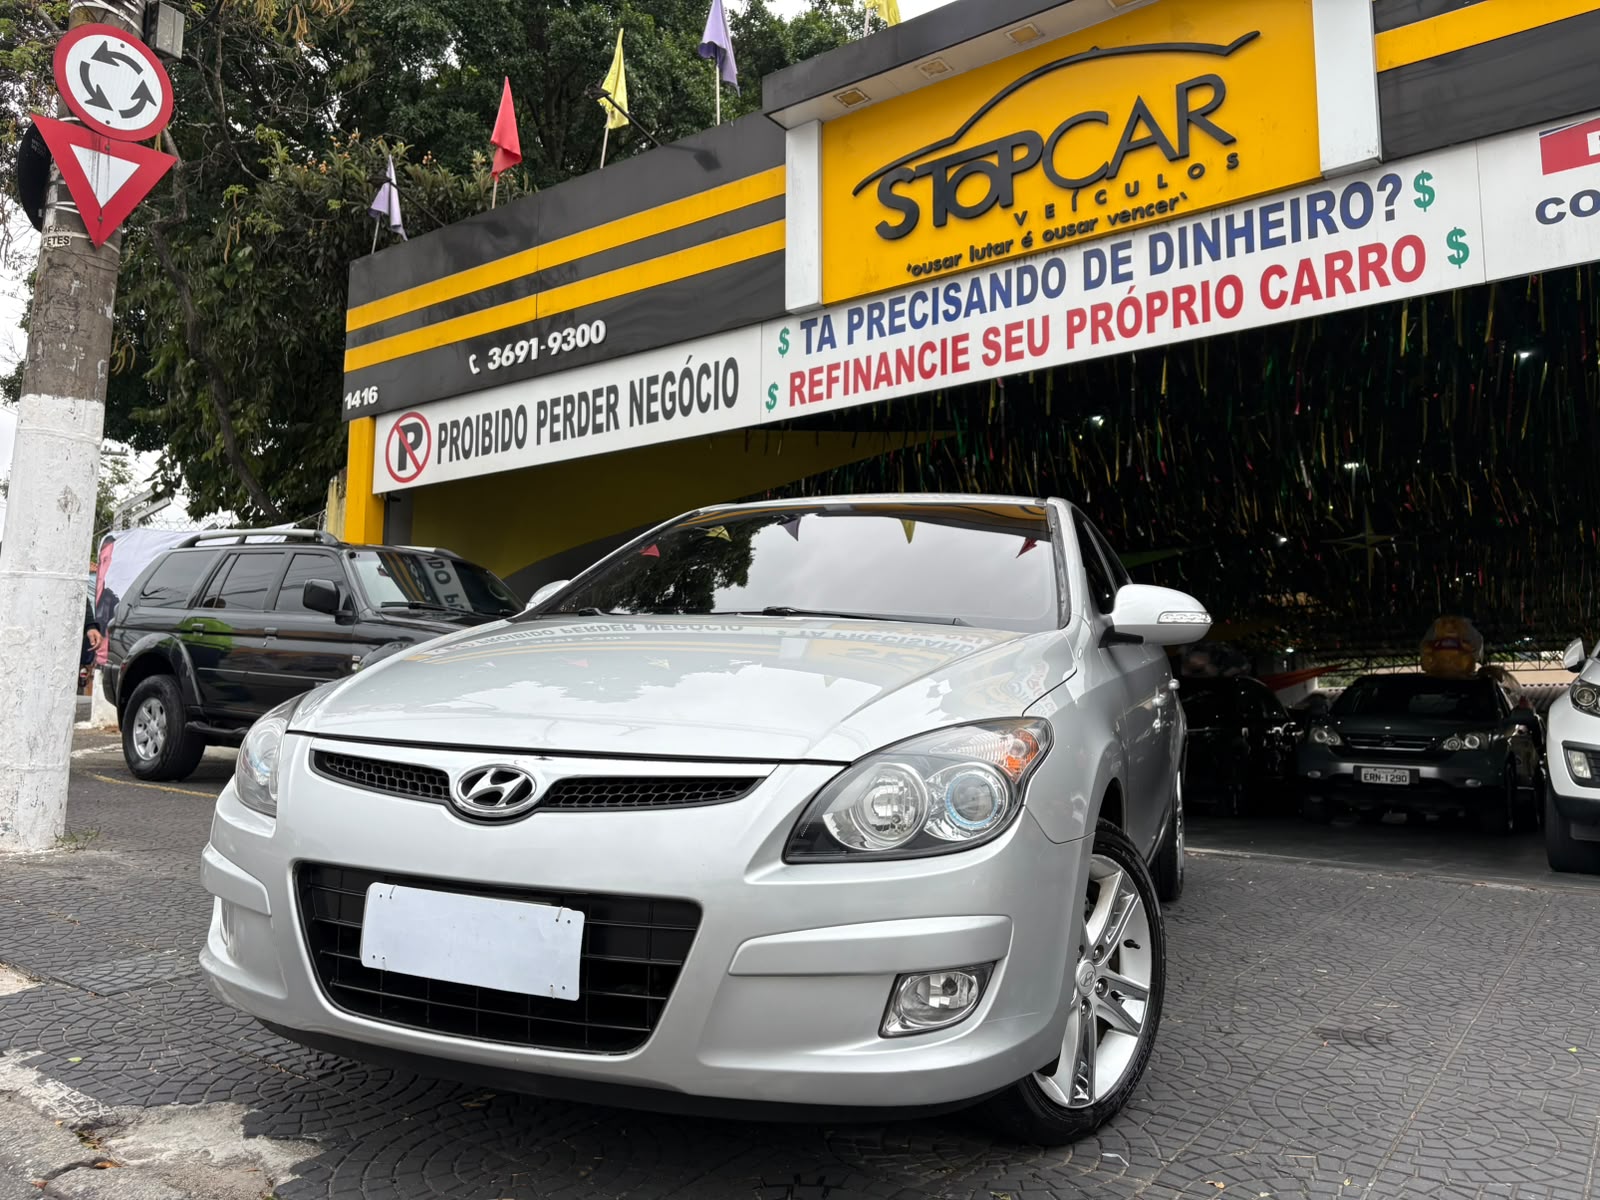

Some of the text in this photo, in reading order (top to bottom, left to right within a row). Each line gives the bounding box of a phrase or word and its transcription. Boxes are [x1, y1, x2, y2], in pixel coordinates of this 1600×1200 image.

[875, 73, 1236, 240] STOPCAR
[800, 314, 837, 355] TA
[848, 257, 1066, 345] PRECISANDO
[1084, 240, 1133, 291] DE
[1149, 173, 1403, 276] DINHEIRO?
[969, 237, 1013, 262] lutar
[1022, 230, 1033, 248] é
[1042, 217, 1097, 241] ousar
[487, 319, 607, 370] 3691-9300
[789, 332, 970, 407] REFINANCIE
[982, 315, 1049, 367] SEU
[1067, 274, 1244, 349] PRÓPRIO
[1259, 234, 1426, 311] CARRO
[345, 385, 378, 410] 1416
[437, 403, 527, 465] PROIBIDO
[536, 384, 620, 446] PERDER
[629, 355, 740, 428] NEGÓCIO
